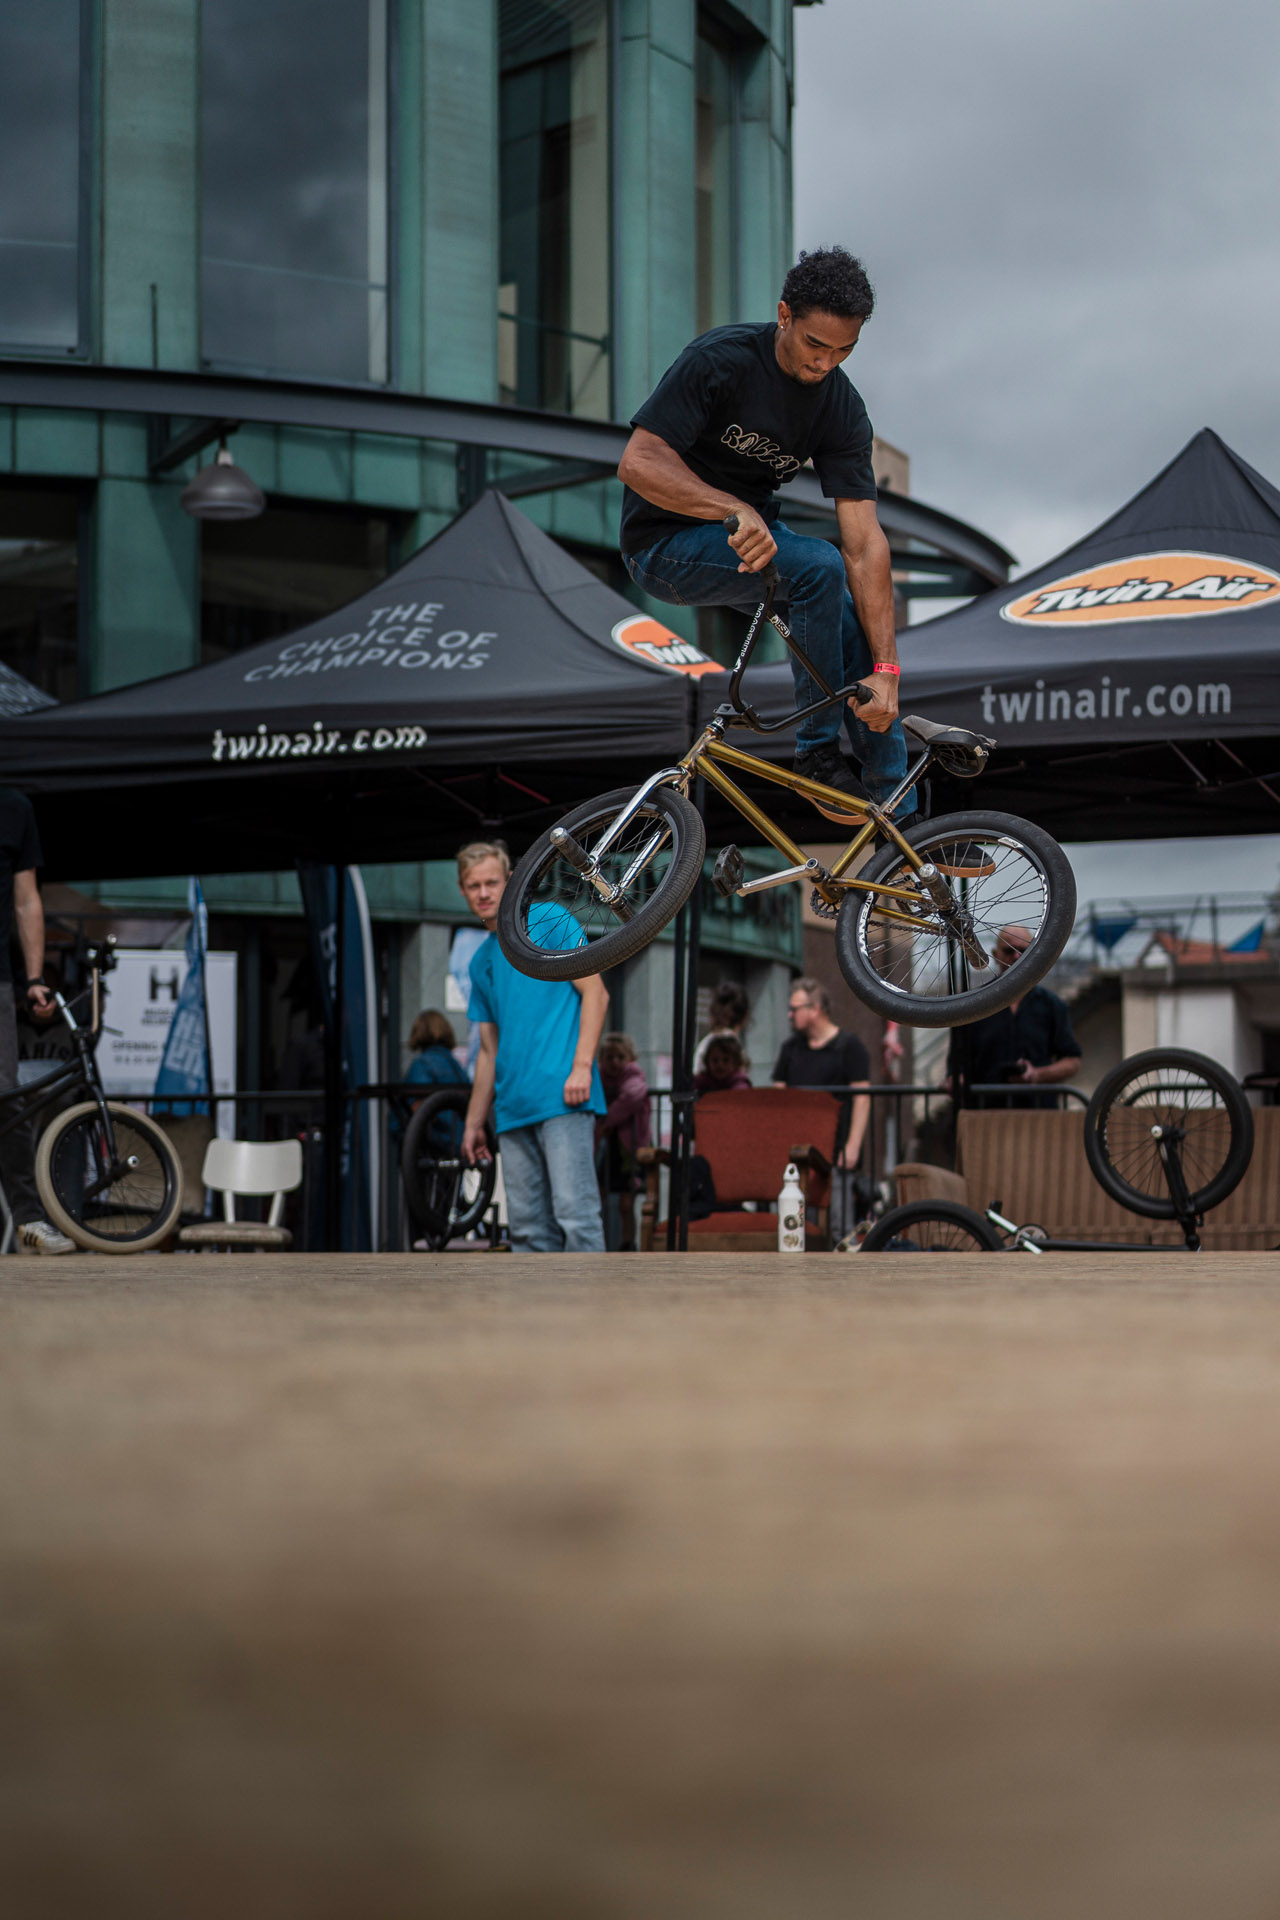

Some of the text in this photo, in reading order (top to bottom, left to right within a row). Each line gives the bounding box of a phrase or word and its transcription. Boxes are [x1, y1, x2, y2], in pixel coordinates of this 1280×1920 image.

[1023, 575, 1275, 615] Twin Air
[367, 602, 444, 627] THE
[278, 625, 498, 661] CHOICE OF
[243, 647, 490, 682] CHAMPIONS
[980, 676, 1232, 724] twinair.com
[212, 721, 428, 761] twinair.com
[149, 965, 179, 1002] H
